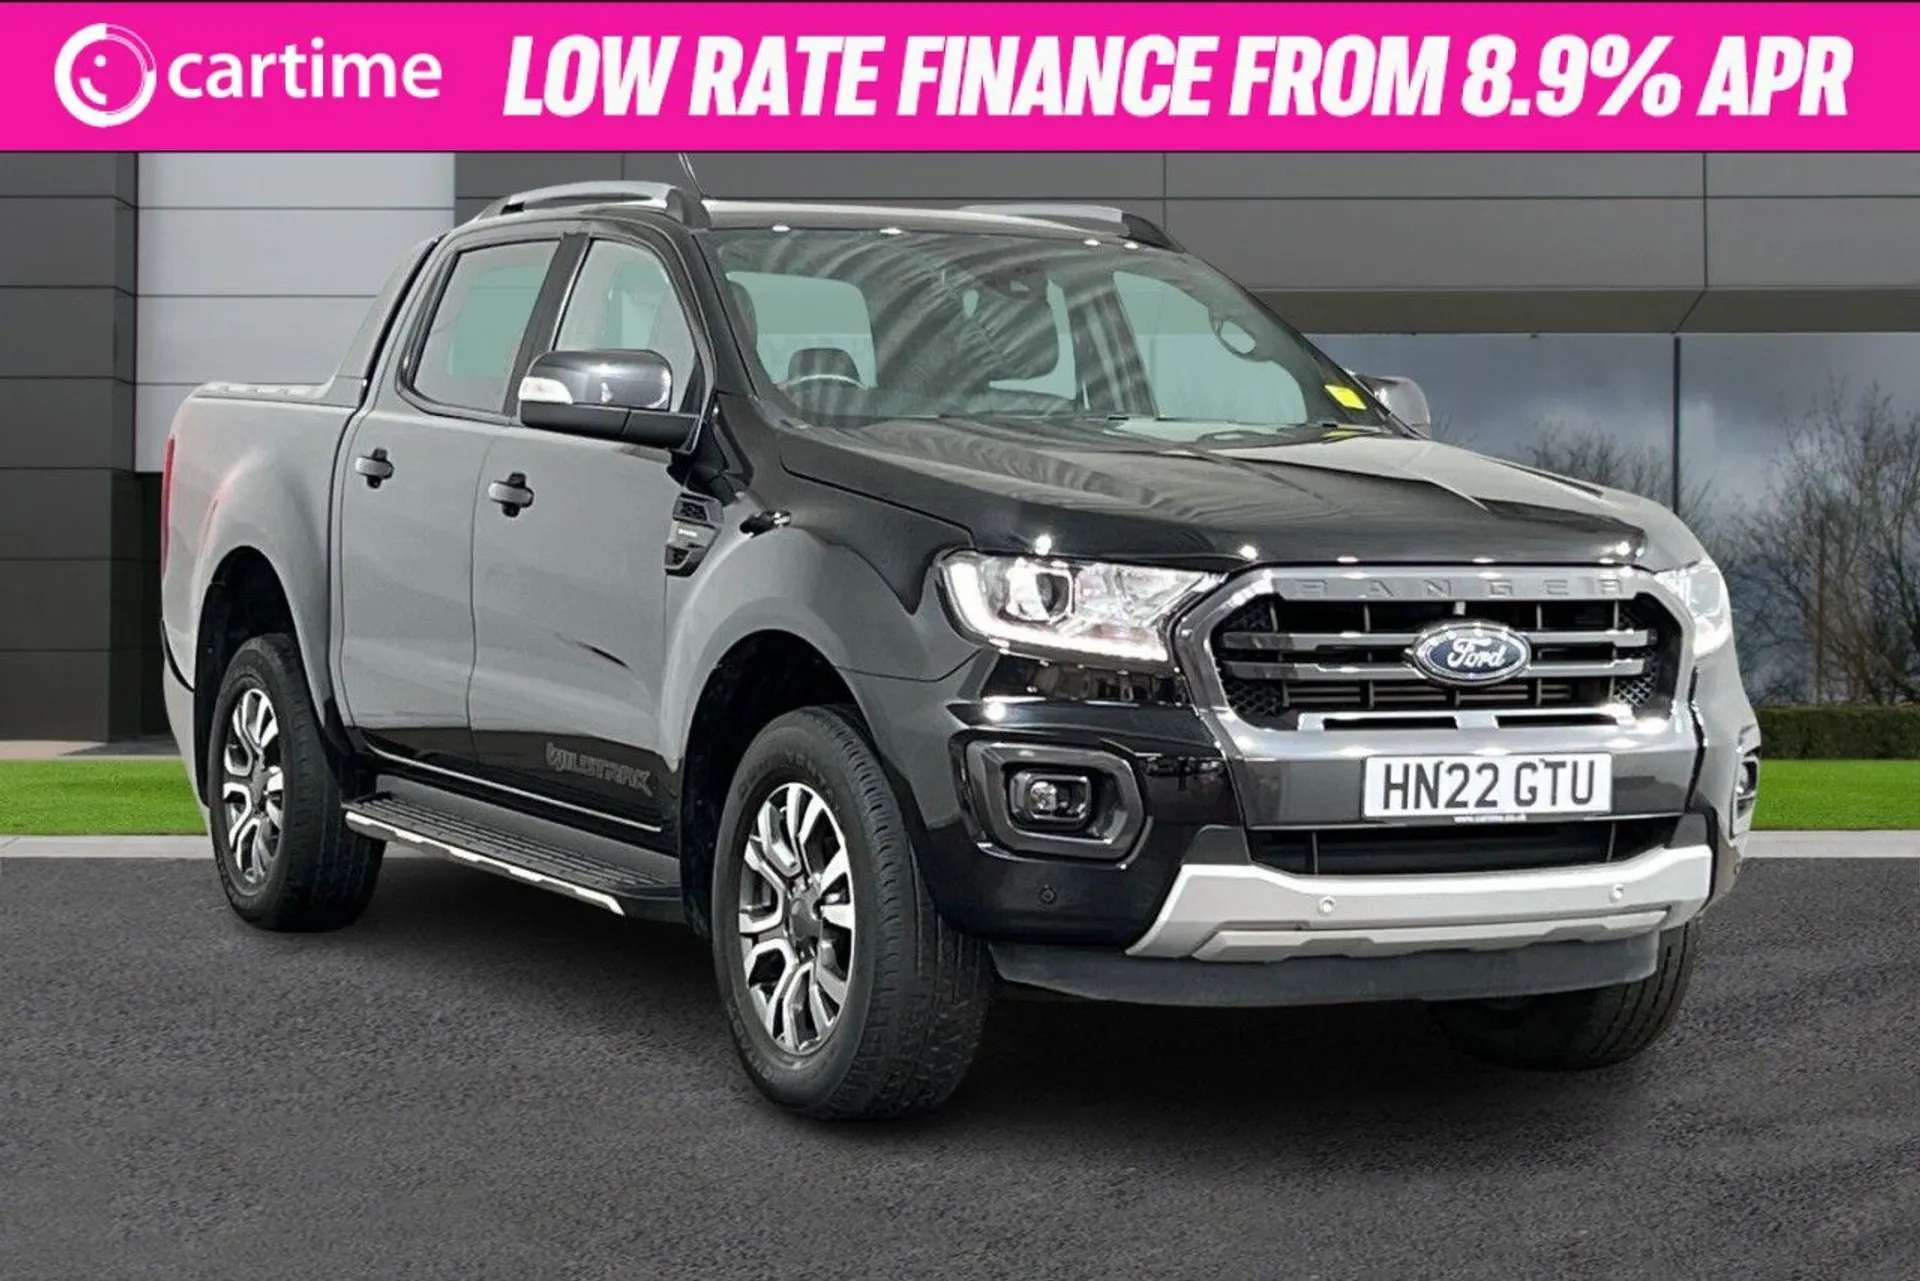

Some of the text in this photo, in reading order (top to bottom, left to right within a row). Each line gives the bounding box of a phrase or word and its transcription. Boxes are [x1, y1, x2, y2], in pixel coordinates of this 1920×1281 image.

[1294, 577, 1624, 598] RANGER
[1447, 638, 1507, 668] Ford
[1383, 758, 1595, 810] HN22 GTU
